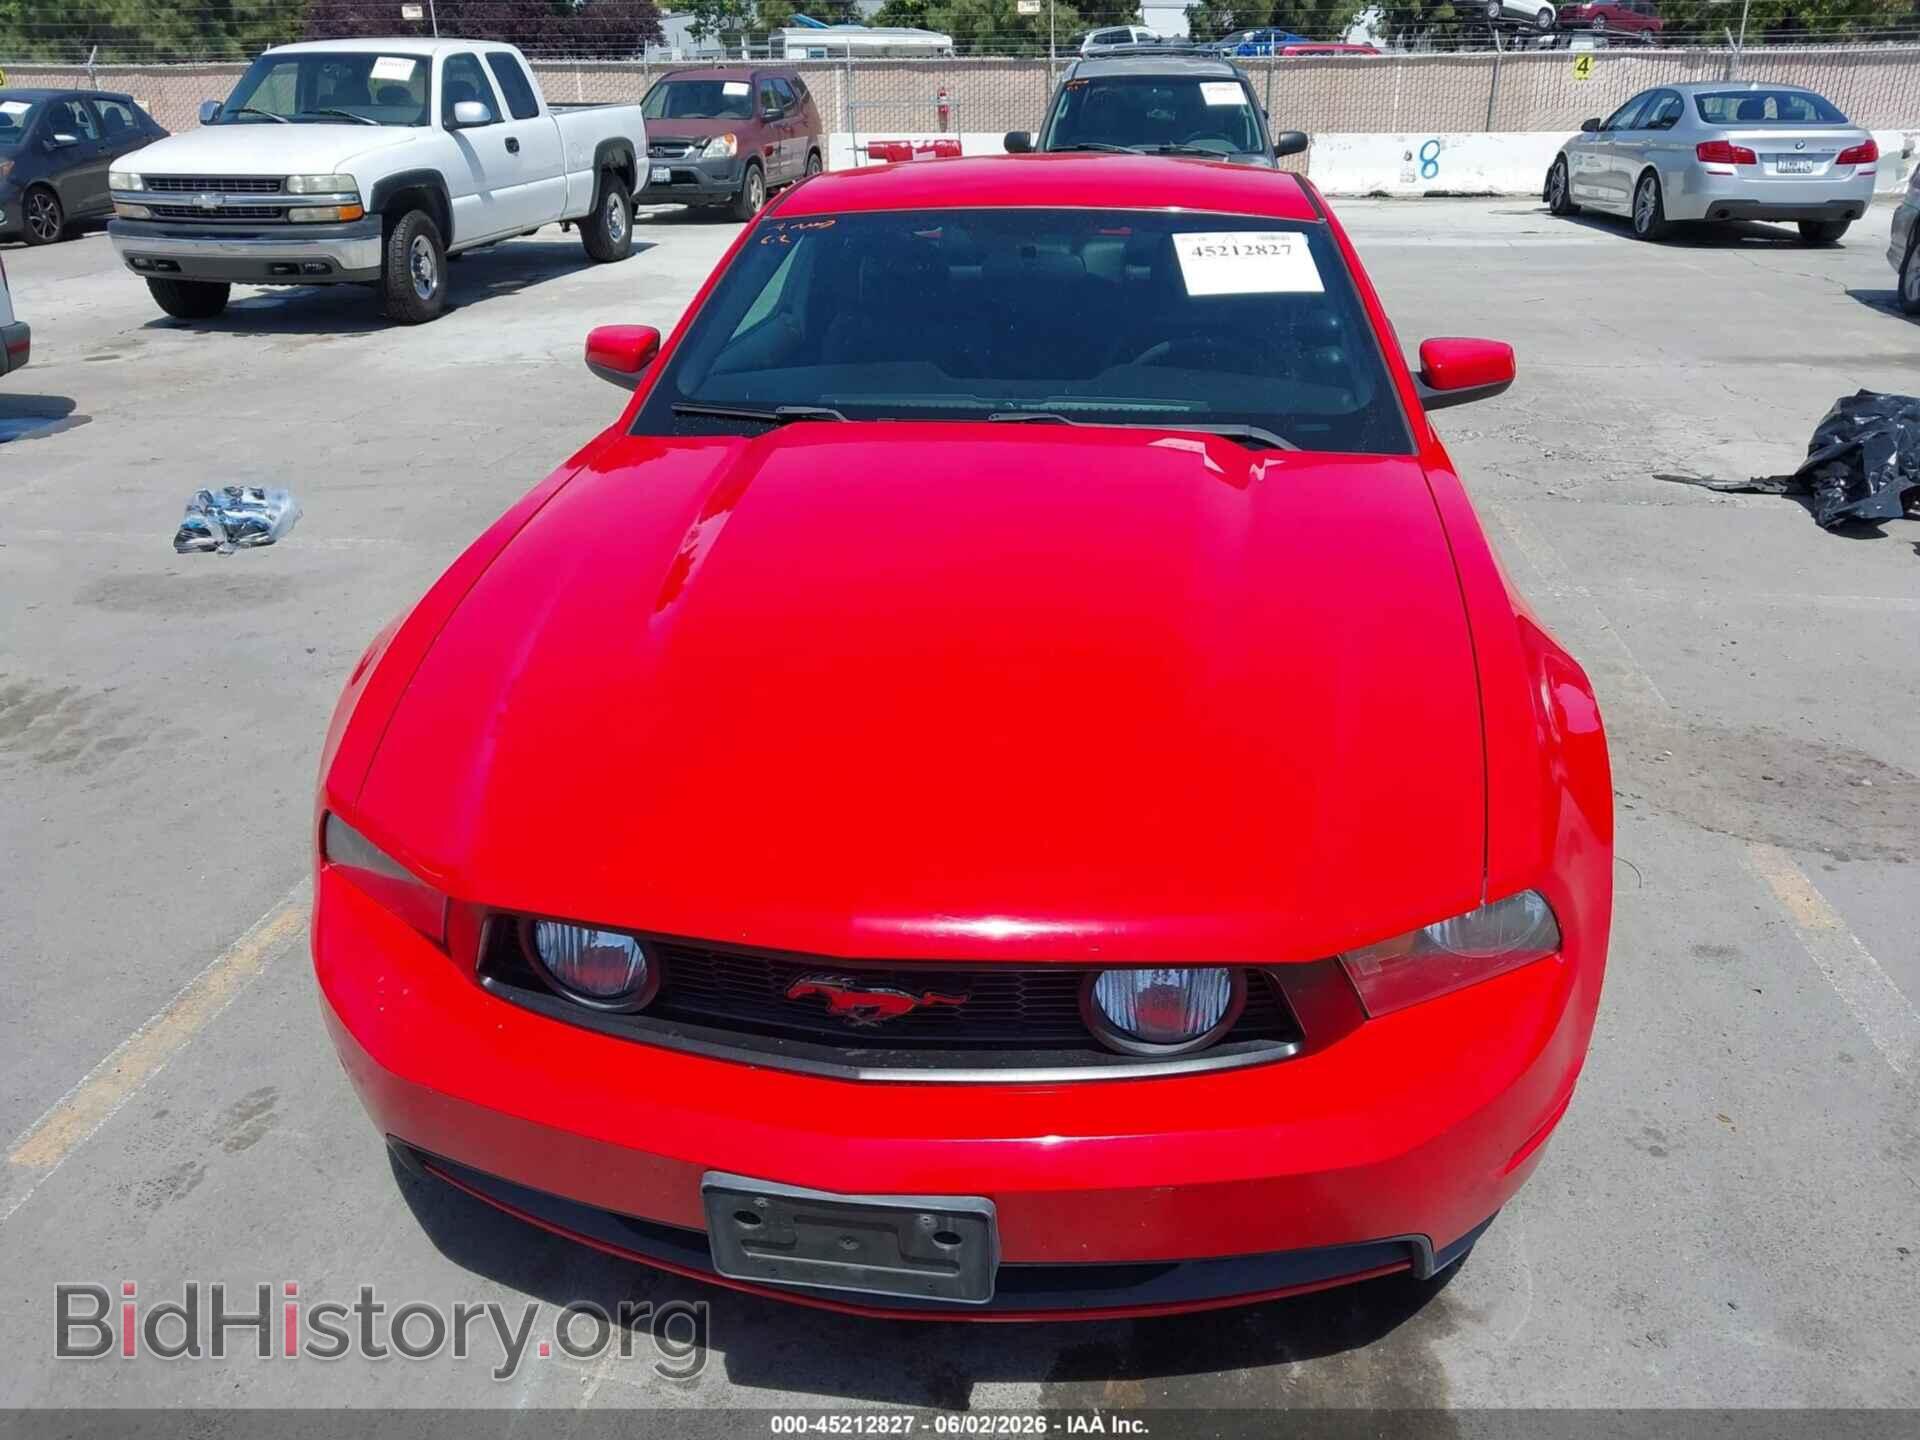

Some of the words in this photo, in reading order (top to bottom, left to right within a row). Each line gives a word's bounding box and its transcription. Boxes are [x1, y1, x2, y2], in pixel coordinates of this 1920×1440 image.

[1577, 56, 1590, 75] 4
[1419, 139, 1441, 180] 8
[1192, 244, 1292, 257] 45212827
